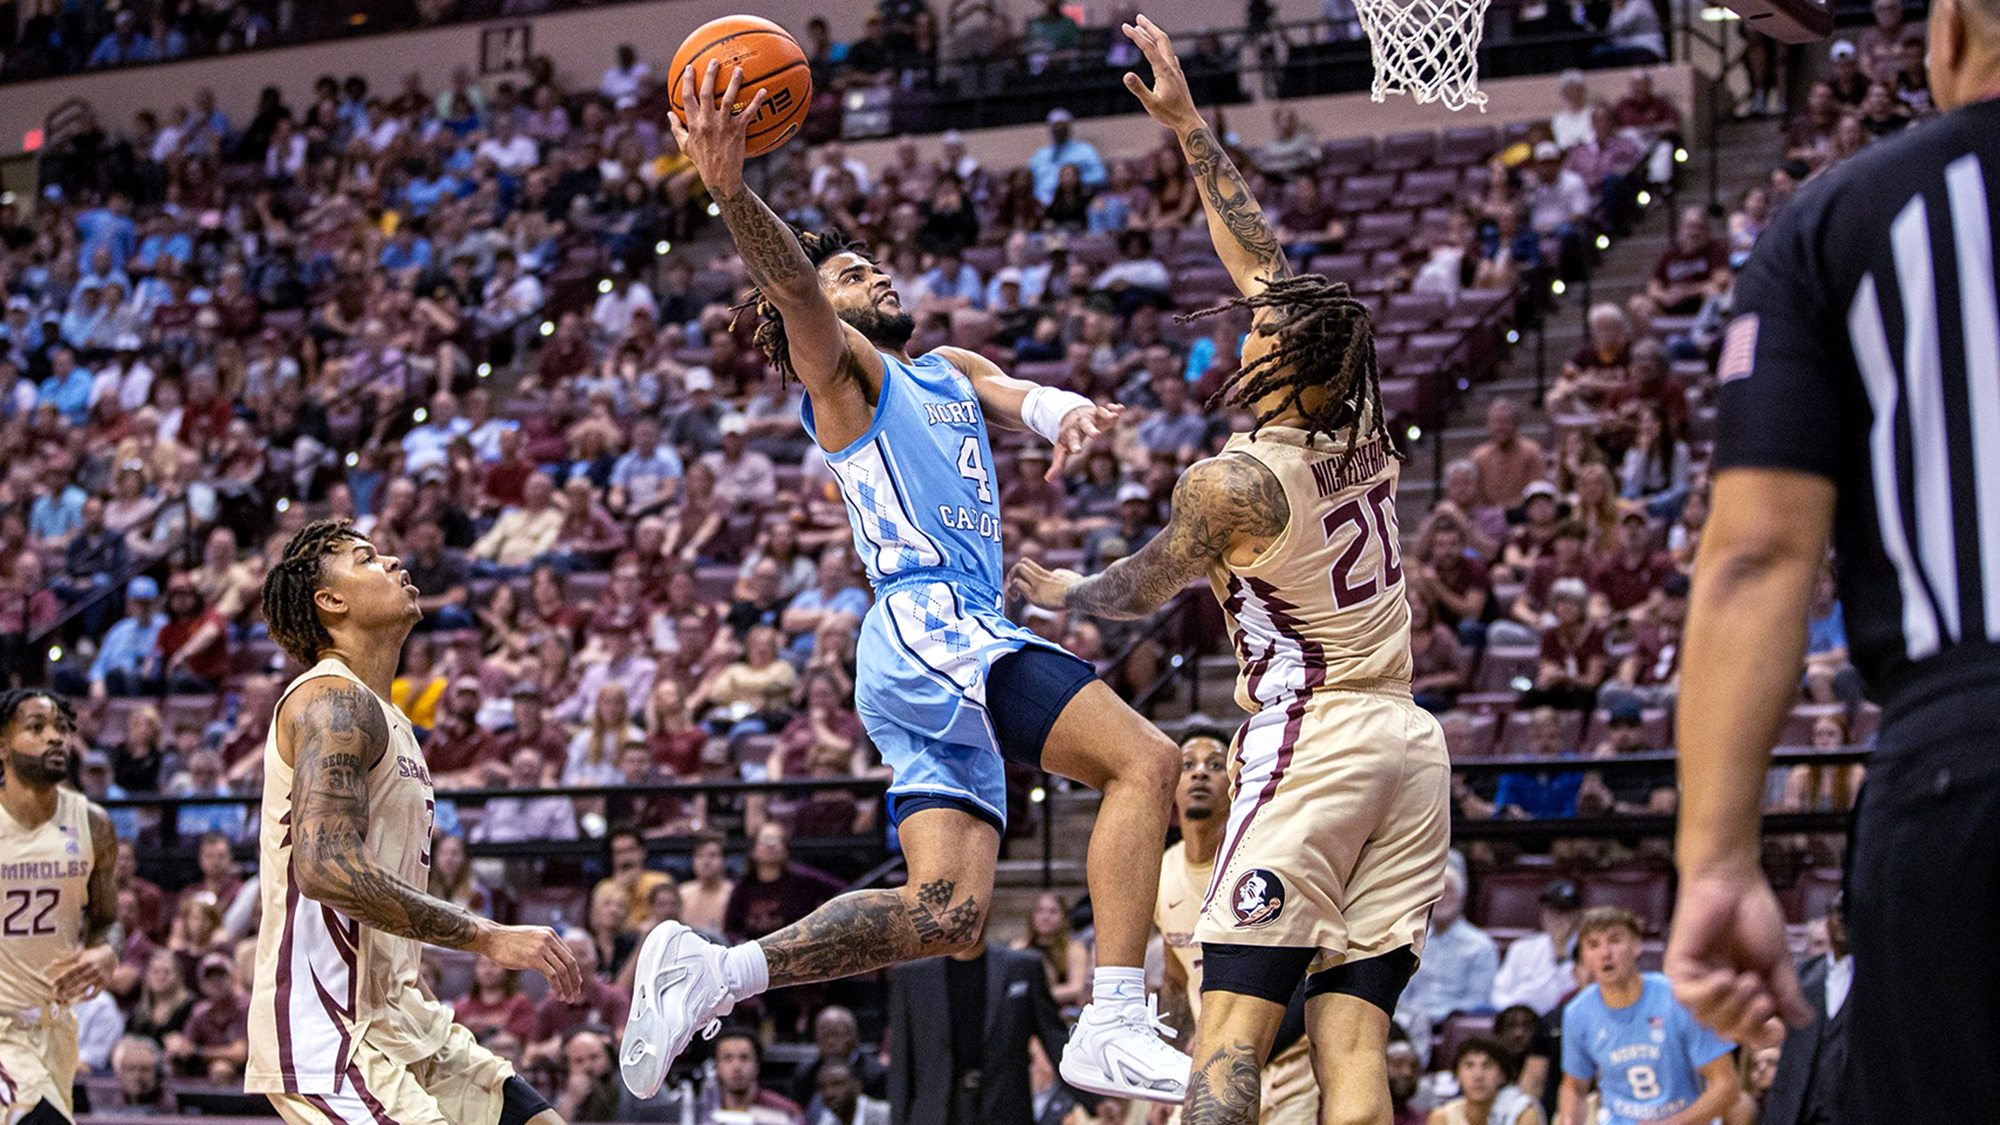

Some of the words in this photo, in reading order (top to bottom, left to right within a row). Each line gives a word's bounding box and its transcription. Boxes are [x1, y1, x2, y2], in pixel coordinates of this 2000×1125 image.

[924, 401, 978, 426] NORT
[957, 436, 993, 504] 4
[1321, 479, 1402, 611] 20
[322, 752, 360, 769] GEORG
[1, 861, 89, 880] MINOLES
[3, 887, 61, 937] 22
[908, 902, 945, 944] TMC
[1627, 1065, 1661, 1100] 8
